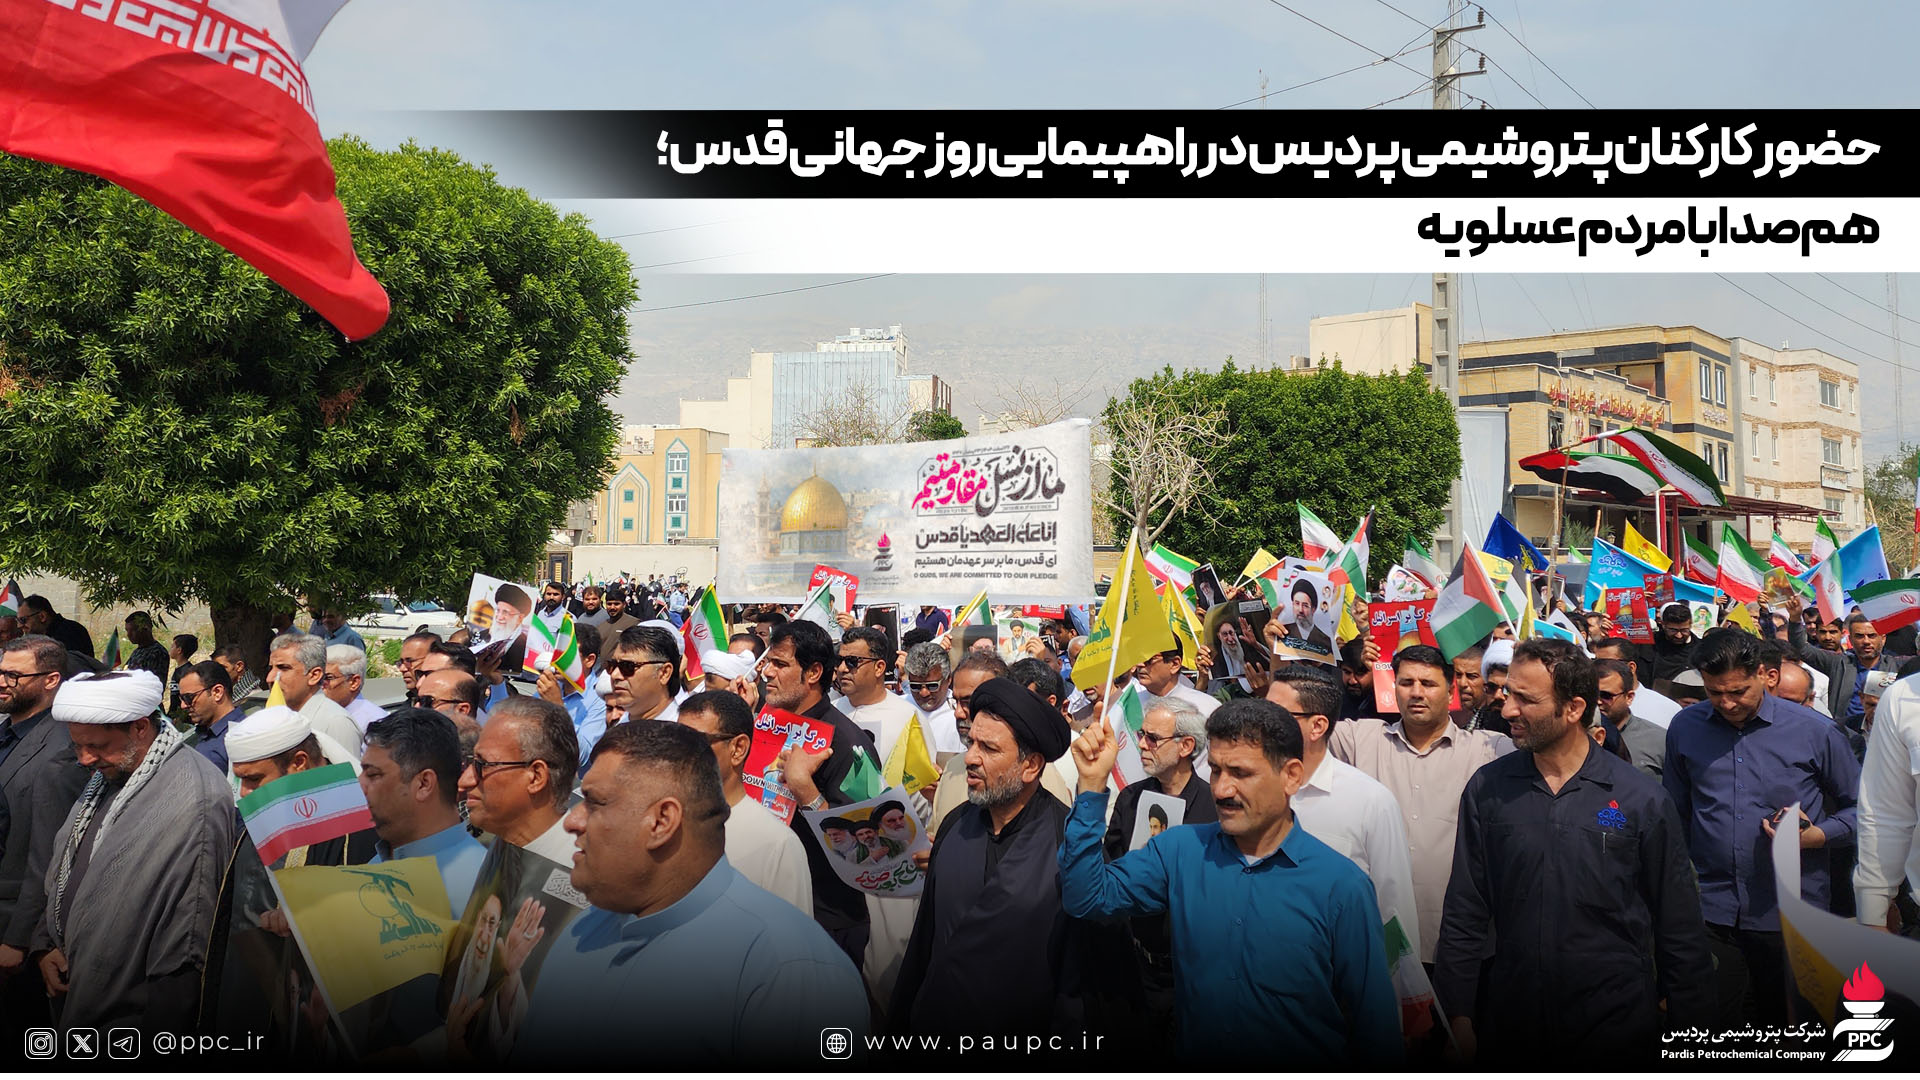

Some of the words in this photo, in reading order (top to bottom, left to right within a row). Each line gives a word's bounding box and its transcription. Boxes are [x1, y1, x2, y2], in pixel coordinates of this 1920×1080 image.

[1045, 555, 1057, 568] ای
[755, 714, 792, 735] اسرائیل
[792, 728, 803, 741] بر
